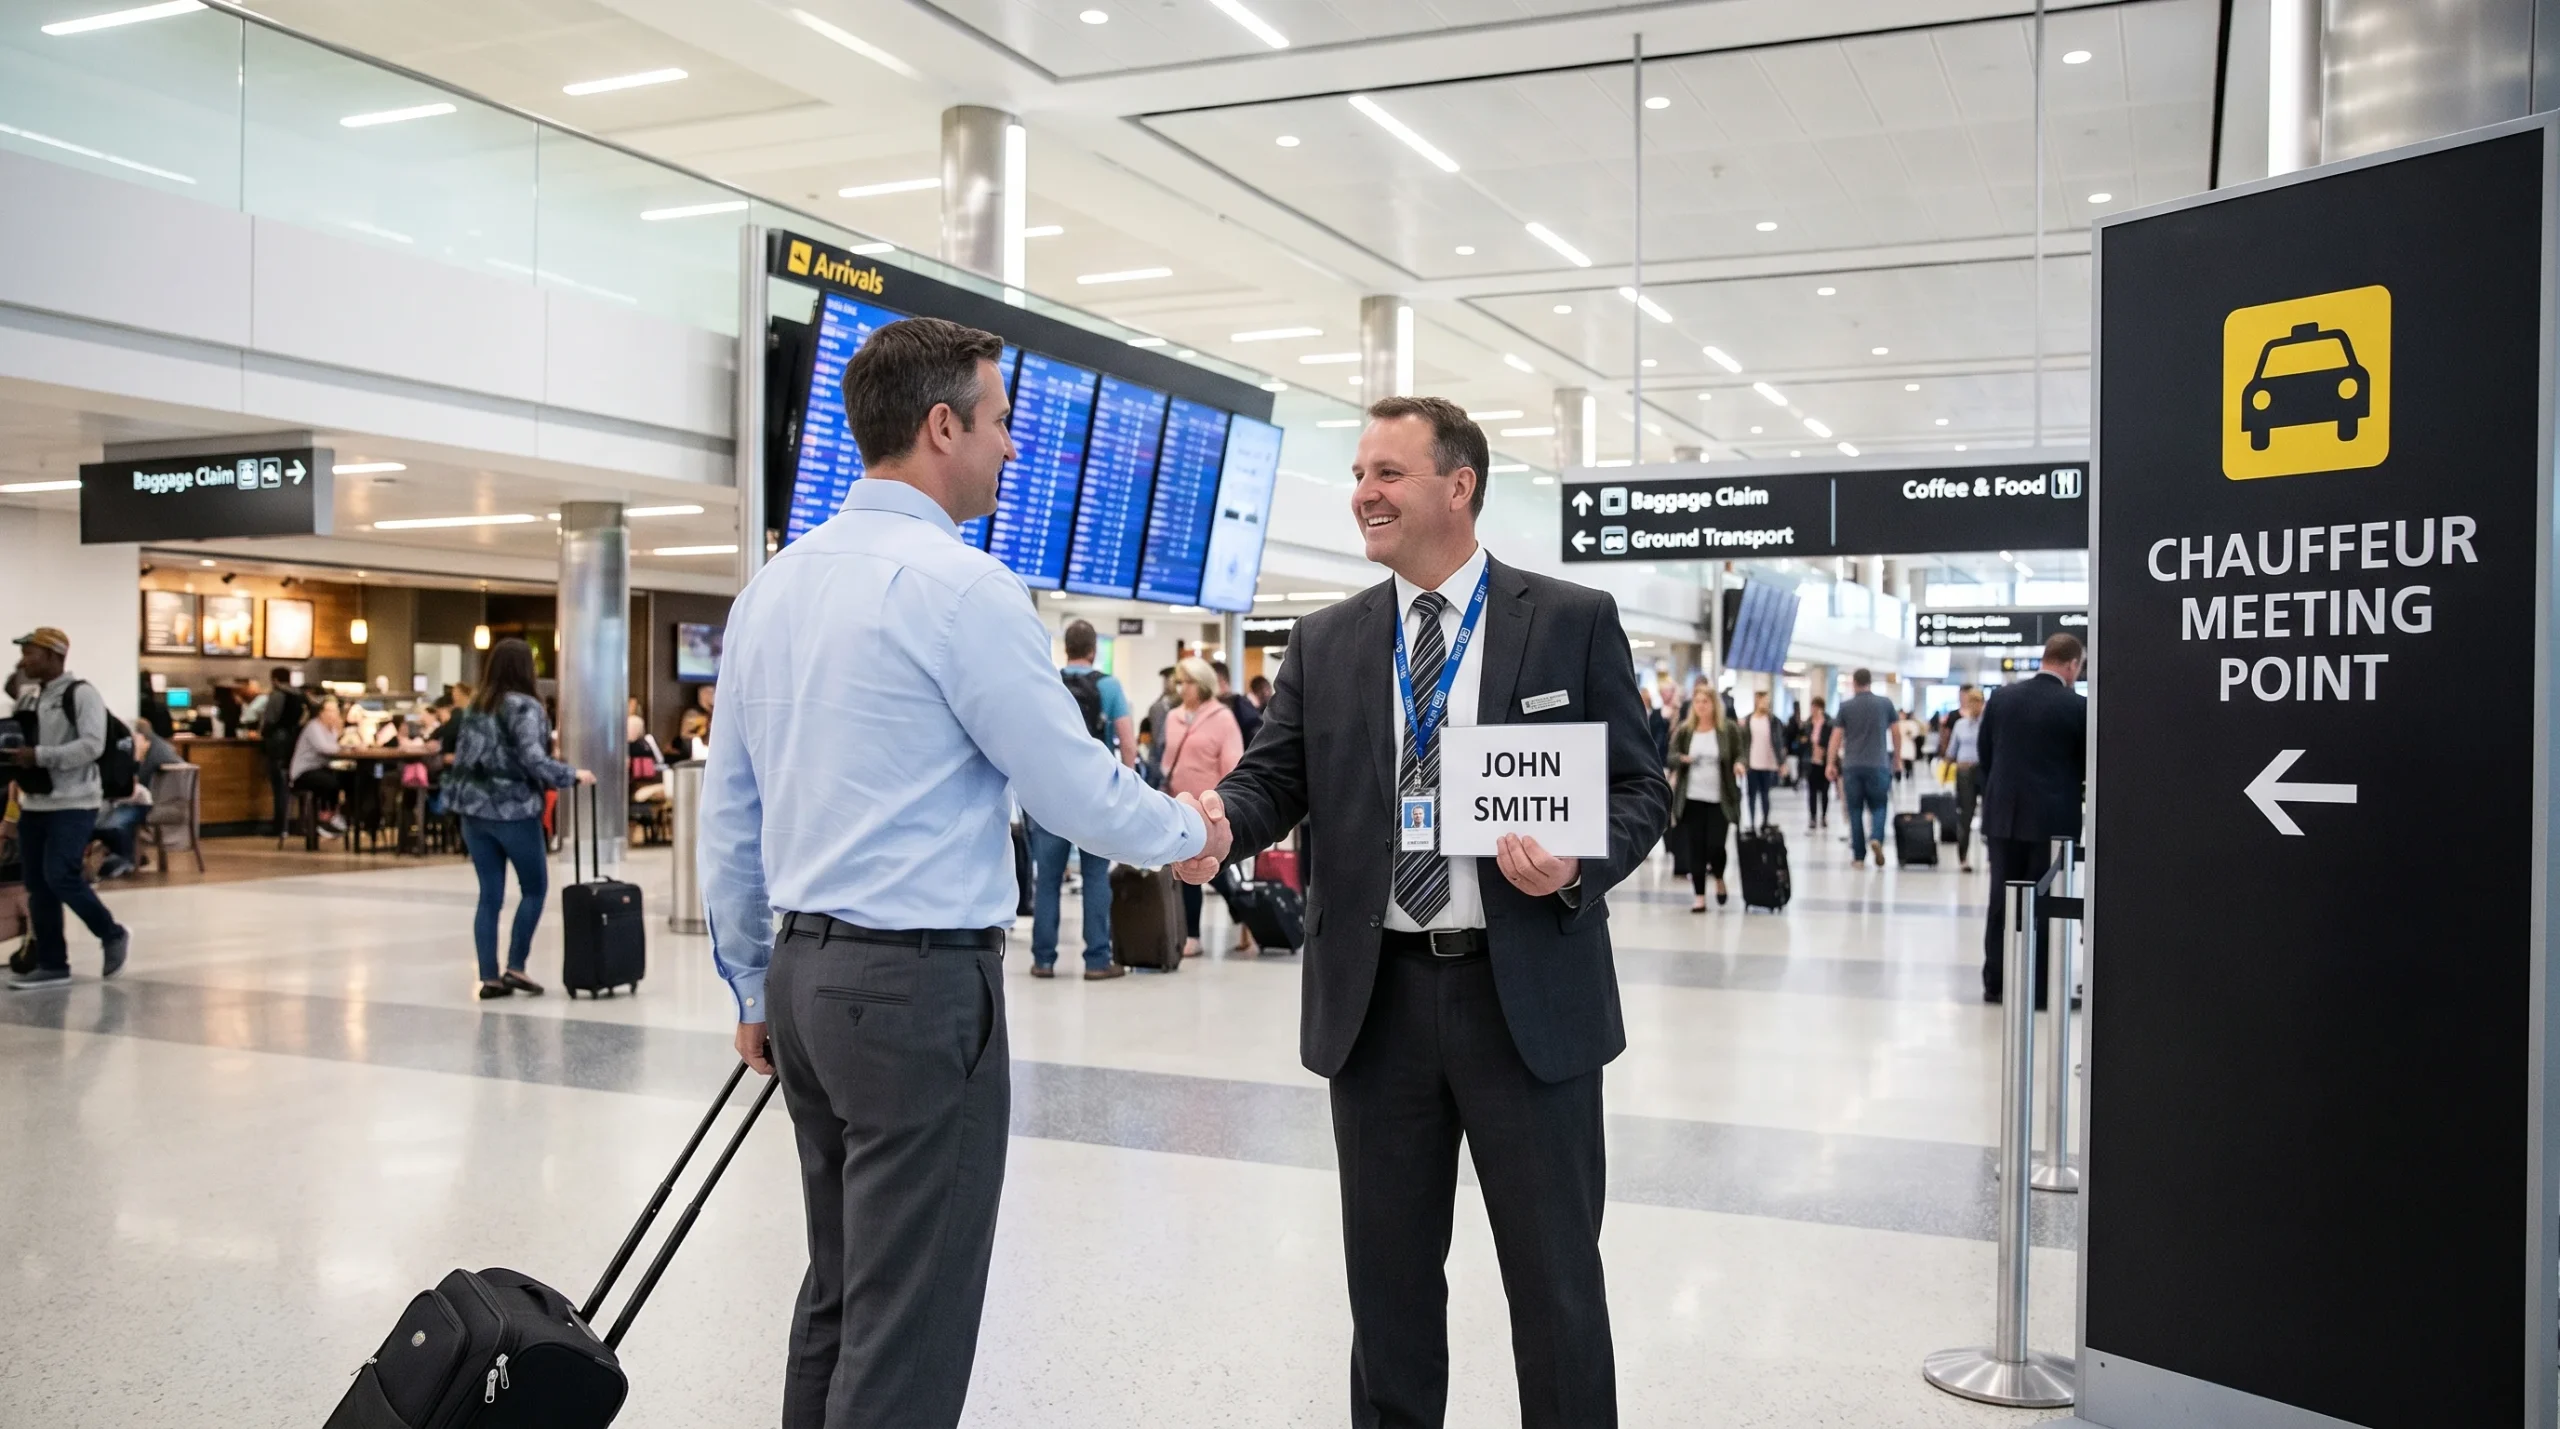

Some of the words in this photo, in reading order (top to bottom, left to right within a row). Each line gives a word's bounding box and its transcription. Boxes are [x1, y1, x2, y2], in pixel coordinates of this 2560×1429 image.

[813, 252, 884, 295] Arrivals
[133, 471, 194, 494] Baggage
[195, 465, 235, 487] Claim
[1902, 477, 1970, 500] Coffee
[1972, 477, 1990, 497] &
[1994, 474, 2047, 497] Food
[1631, 491, 1713, 514] Baggage
[1715, 485, 1769, 507] Claim
[1631, 527, 1700, 549] Ground
[1702, 526, 1795, 550] Transport
[2147, 515, 2479, 582] CHAUFFEUR
[2181, 585, 2432, 641] MEETING
[2219, 653, 2389, 702] POINT
[1481, 751, 1561, 778] JOHN
[1474, 796, 1569, 822] SMITH
